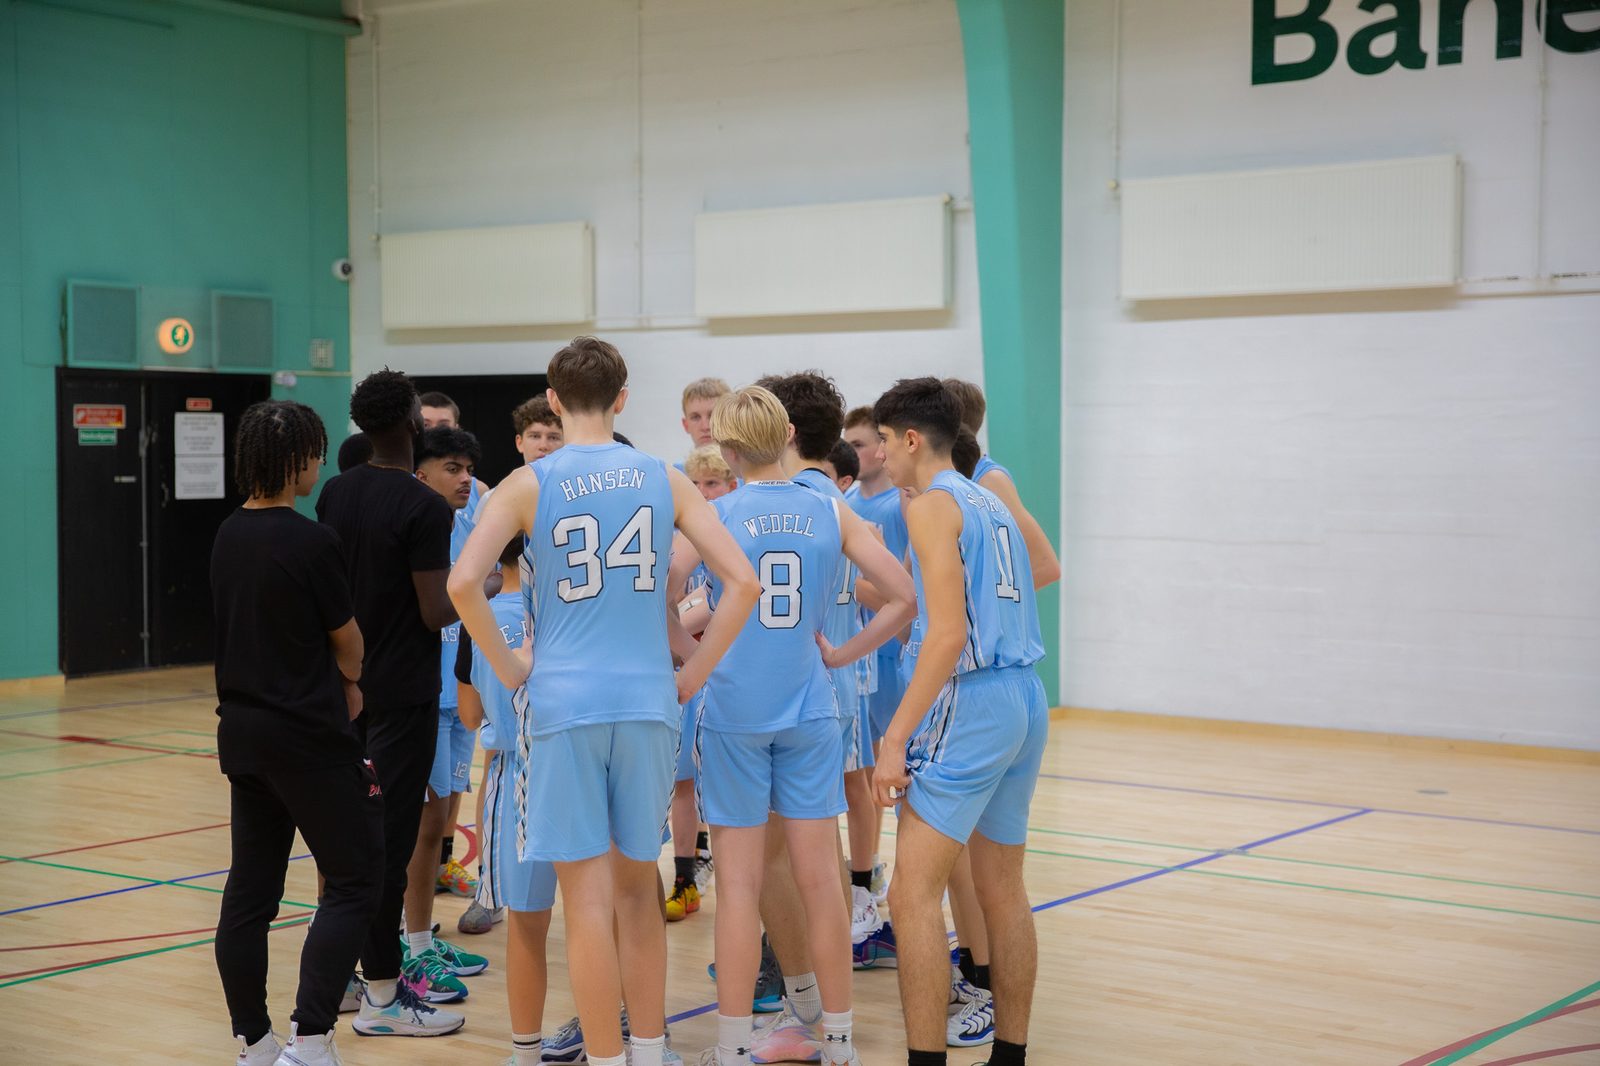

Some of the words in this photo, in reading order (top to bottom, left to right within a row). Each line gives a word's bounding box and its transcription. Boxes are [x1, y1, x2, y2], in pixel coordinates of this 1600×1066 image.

[559, 467, 646, 502] HANSEN
[743, 513, 816, 538] WEDELL
[552, 505, 657, 604] 34
[758, 550, 803, 629] 8
[440, 627, 460, 642] AS
[452, 759, 468, 779] 12
